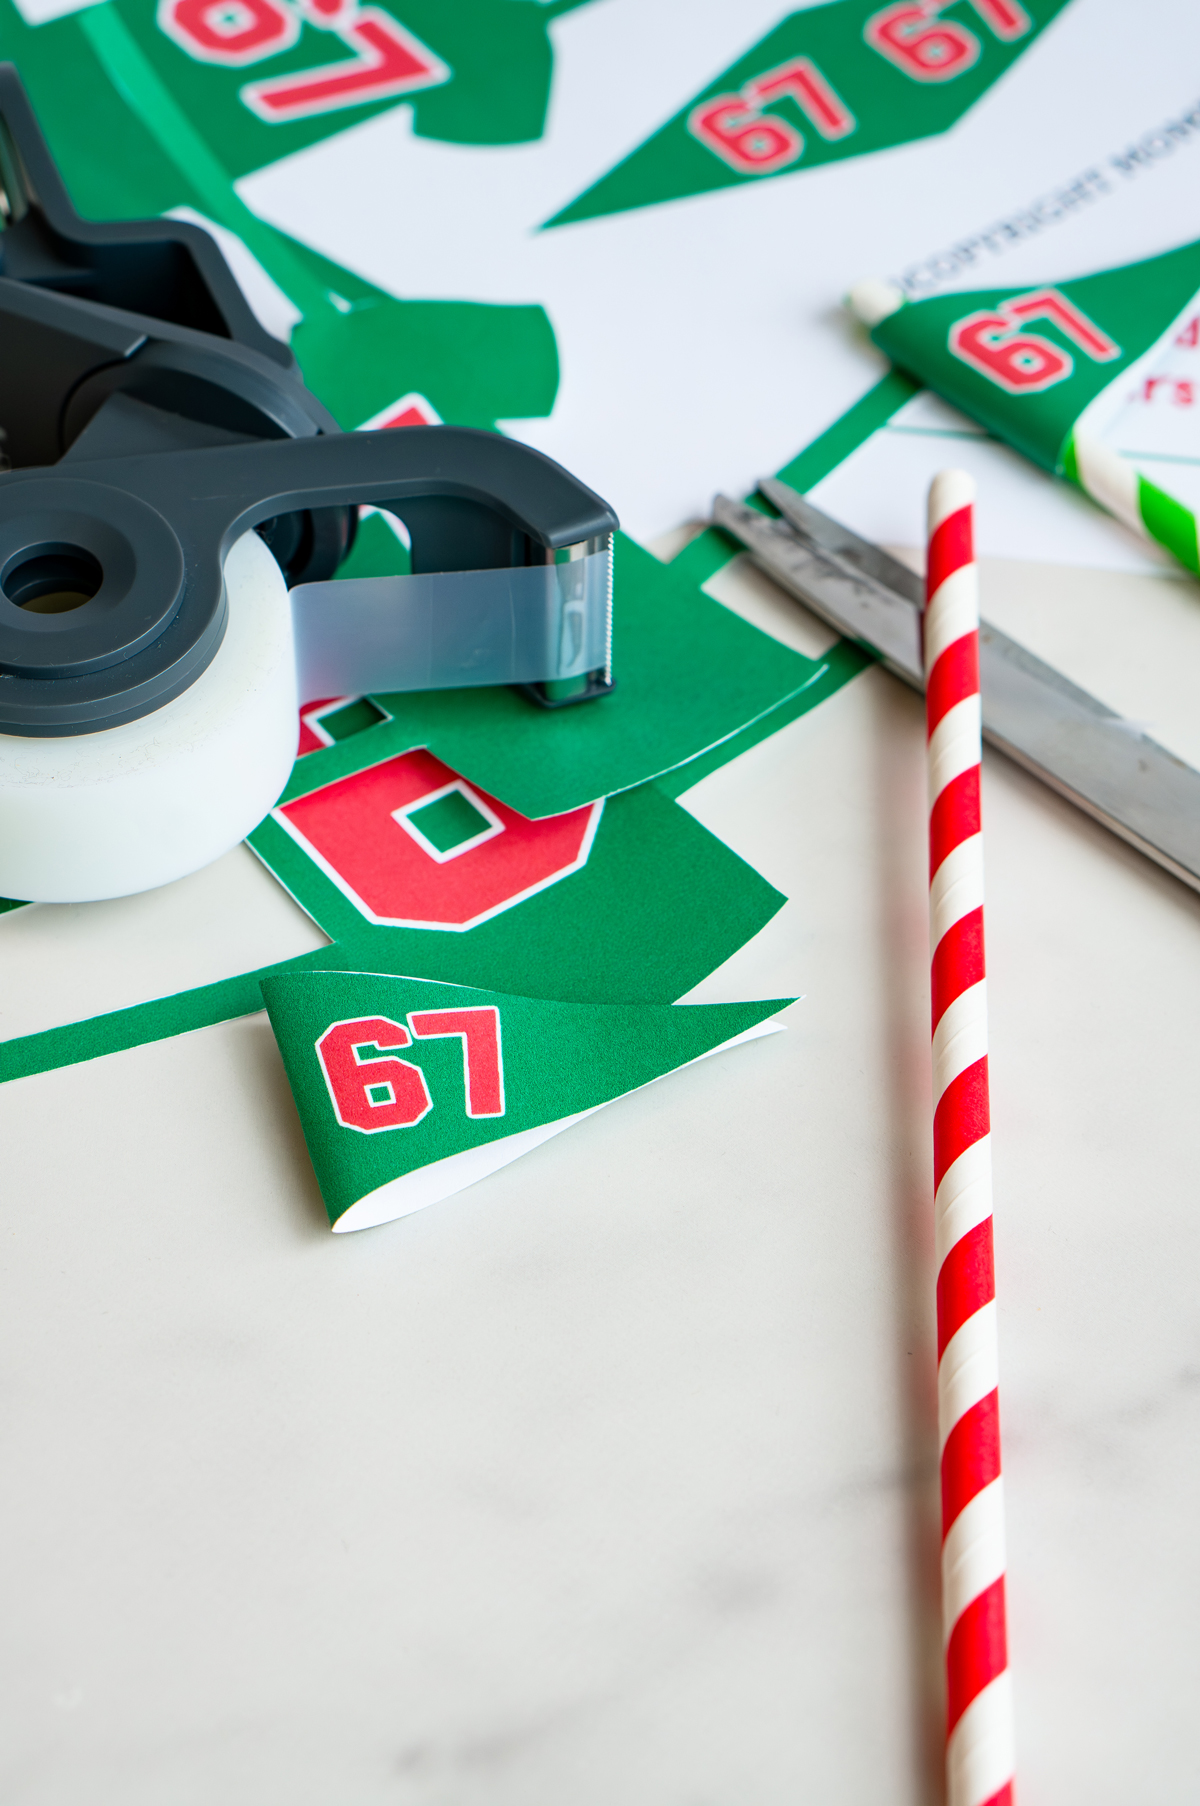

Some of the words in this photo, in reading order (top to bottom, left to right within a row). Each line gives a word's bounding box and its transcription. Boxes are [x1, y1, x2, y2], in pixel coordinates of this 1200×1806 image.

[688, 55, 856, 174] 67
[949, 288, 1120, 394] 67
[316, 1006, 506, 1133] 67
